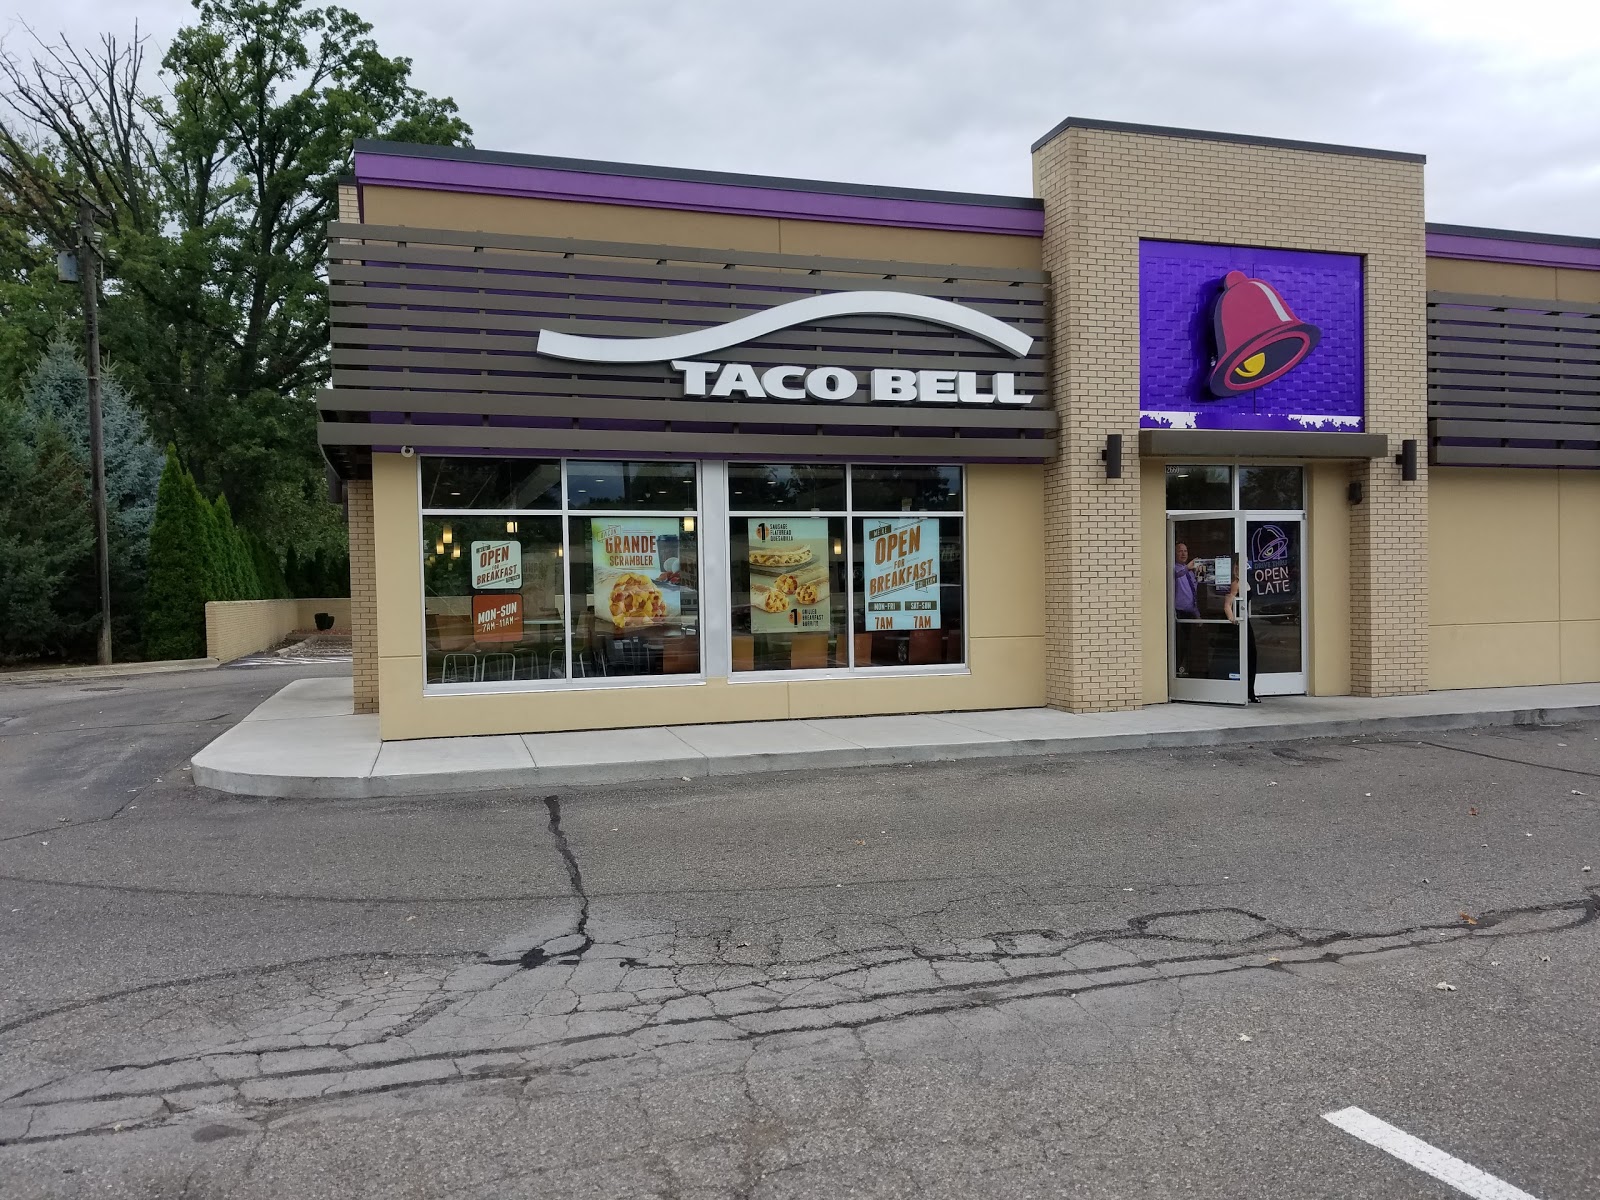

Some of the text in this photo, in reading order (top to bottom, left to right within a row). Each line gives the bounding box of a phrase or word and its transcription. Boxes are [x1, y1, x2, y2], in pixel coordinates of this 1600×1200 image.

[671, 361, 1034, 405] TACO BELL
[605, 536, 657, 553] GRANDE
[875, 525, 921, 566] OPEN
[480, 545, 509, 568] OPEN
[609, 555, 653, 566] SCRAMBLER
[894, 558, 905, 569] FOR
[1254, 561, 1271, 570] DRIVE
[476, 564, 517, 585] BREAKFAST
[869, 558, 934, 596] BREAKFAST
[1254, 566, 1289, 582] OPEN
[1256, 580, 1290, 595] LATE
[478, 602, 517, 624] MON-SUN
[873, 602, 896, 610] MON-FRI
[910, 601, 932, 610] SAT-SUN
[875, 616, 893, 629] 7AM
[913, 615, 931, 628] 7AM
